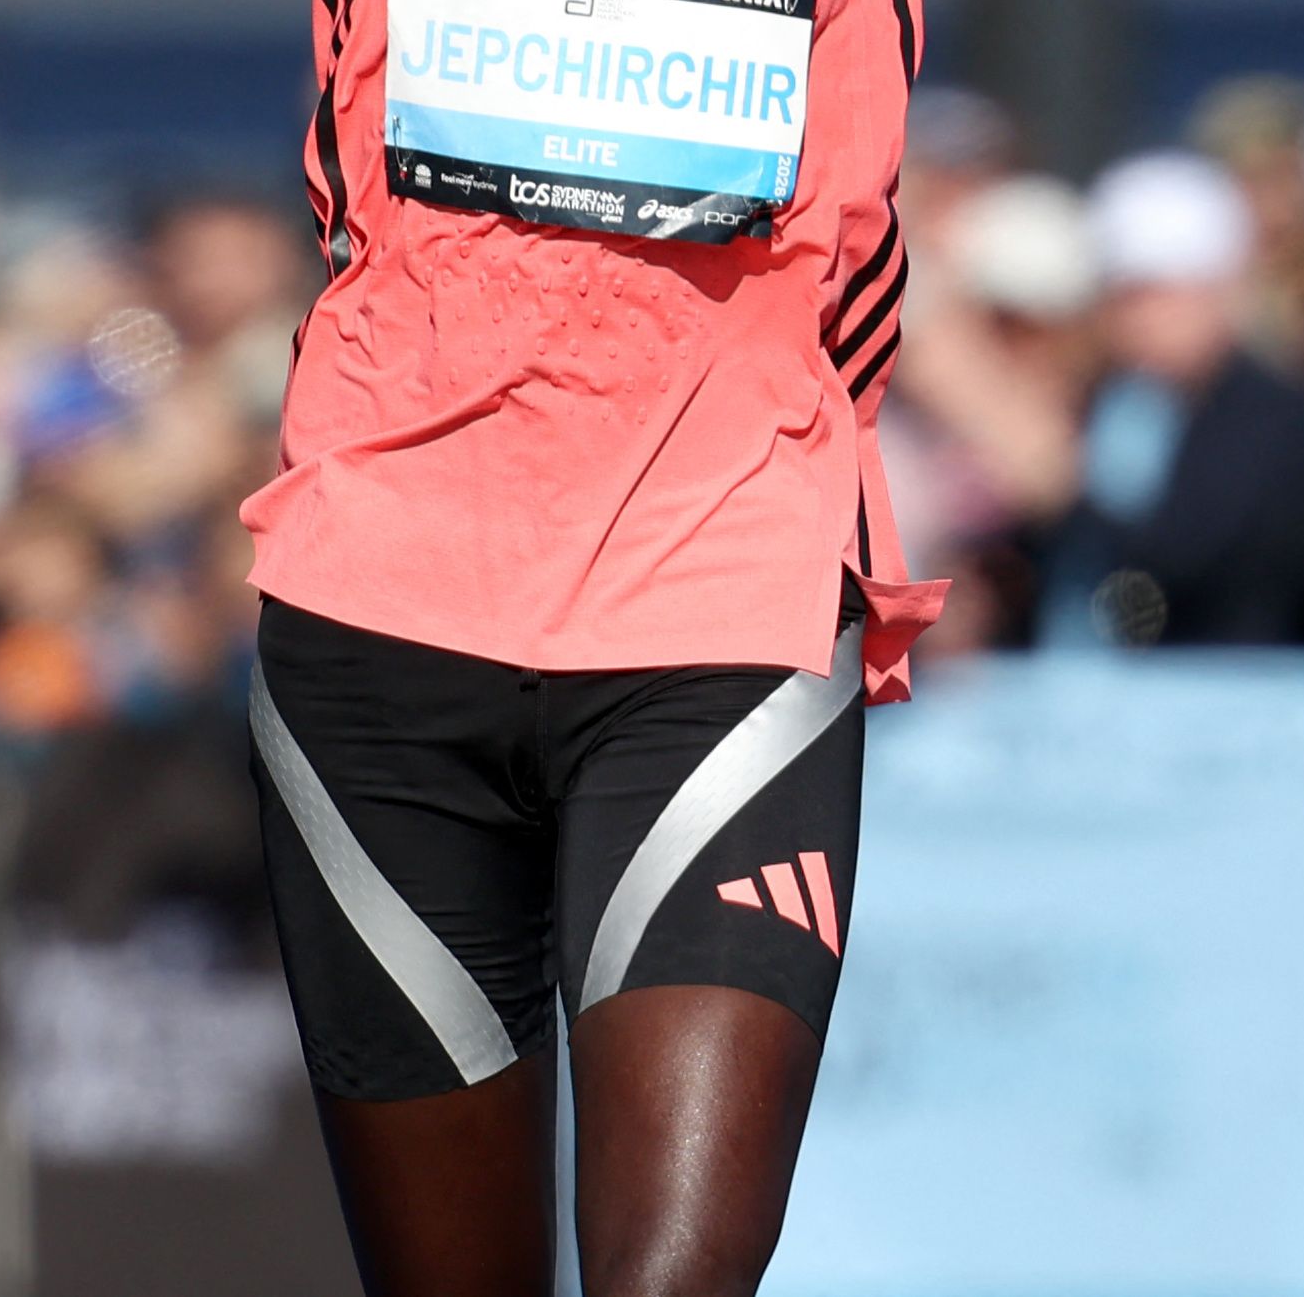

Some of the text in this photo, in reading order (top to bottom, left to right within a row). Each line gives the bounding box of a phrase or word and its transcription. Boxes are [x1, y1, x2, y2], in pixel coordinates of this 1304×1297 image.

[401, 18, 797, 125] JEPCHIRCHIR
[542, 134, 620, 169] ELITE
[509, 173, 551, 208] tcs
[551, 184, 601, 203] SYDNEY
[551, 197, 625, 216] MARATHON
